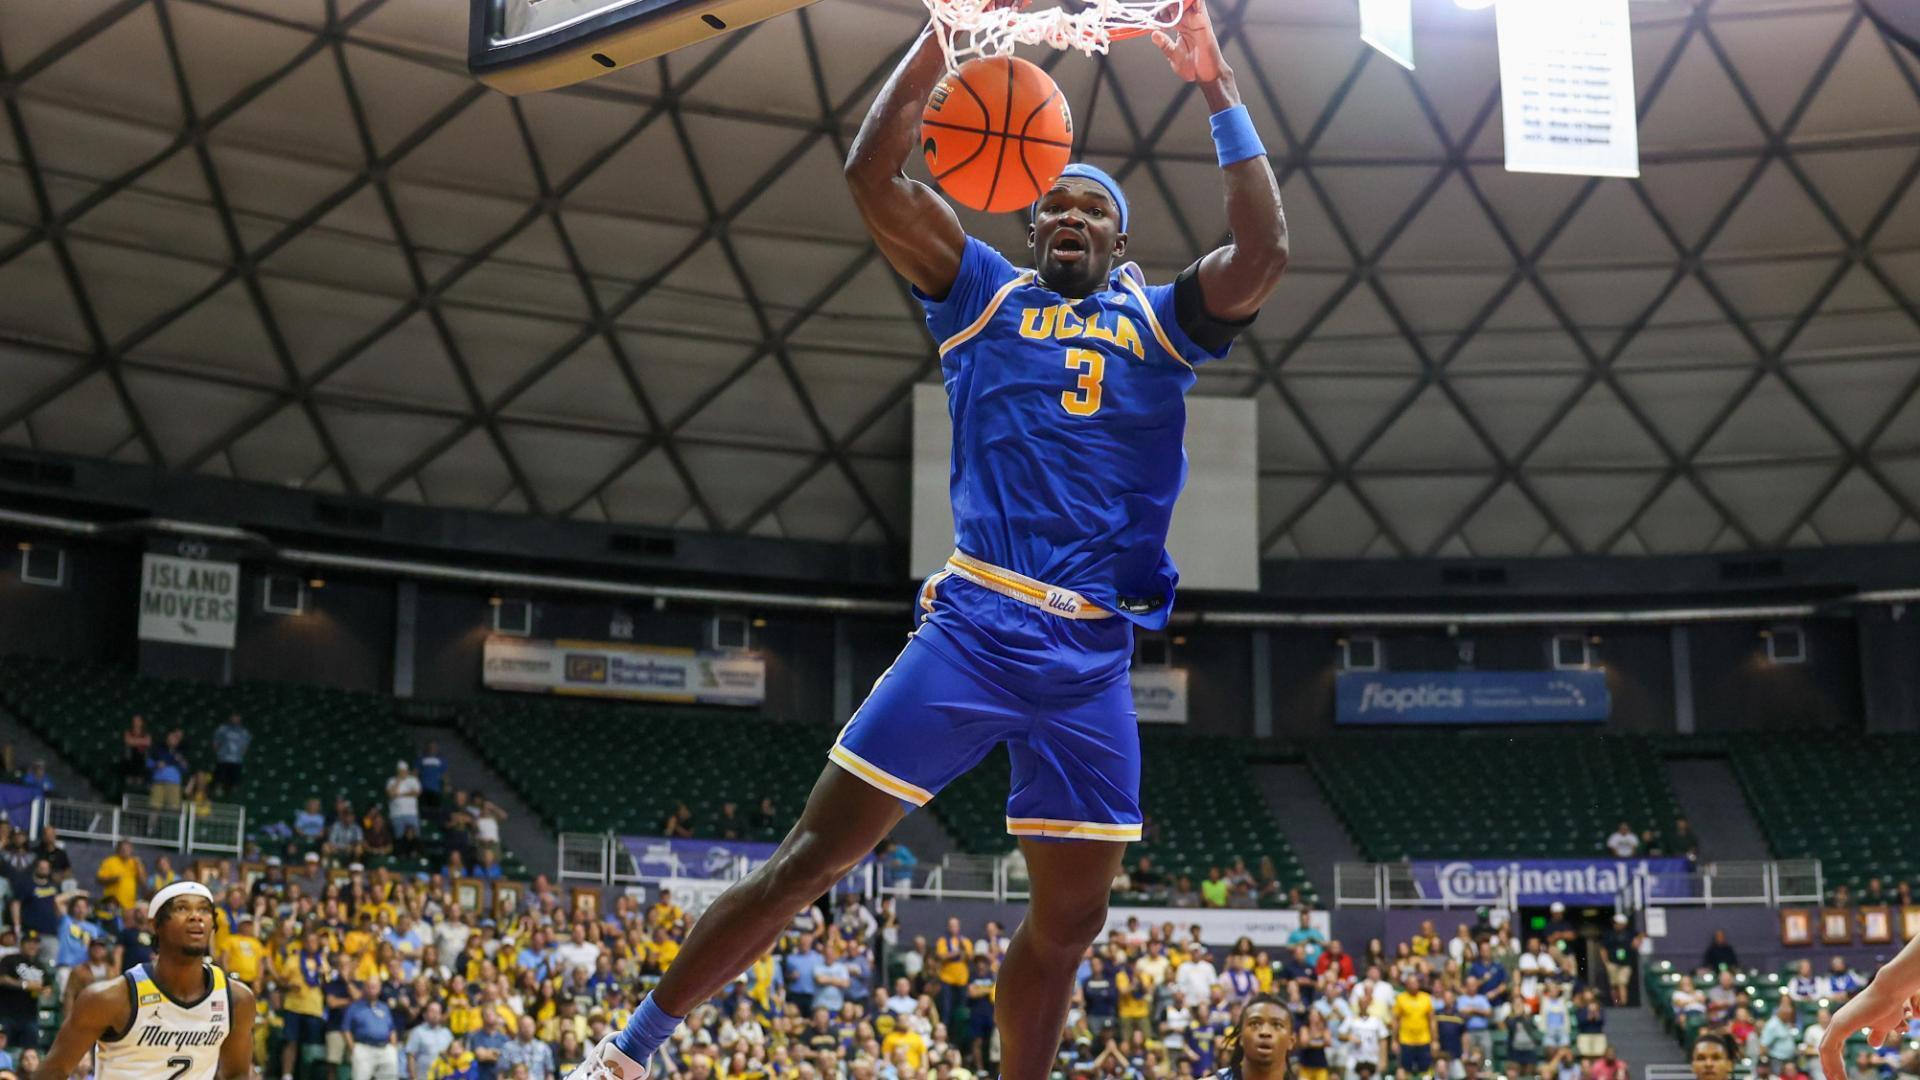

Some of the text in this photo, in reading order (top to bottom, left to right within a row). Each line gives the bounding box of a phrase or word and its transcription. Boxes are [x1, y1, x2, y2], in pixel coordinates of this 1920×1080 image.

[1019, 304, 1145, 361] UCLA
[1061, 348, 1105, 417] 3
[150, 562, 232, 595] ISLAND
[143, 591, 237, 623] MOVERS
[1048, 592, 1076, 613] Ucla
[1438, 861, 1628, 901] Continental
[137, 1025, 224, 1051] Marquette
[167, 1056, 193, 1080] 2
